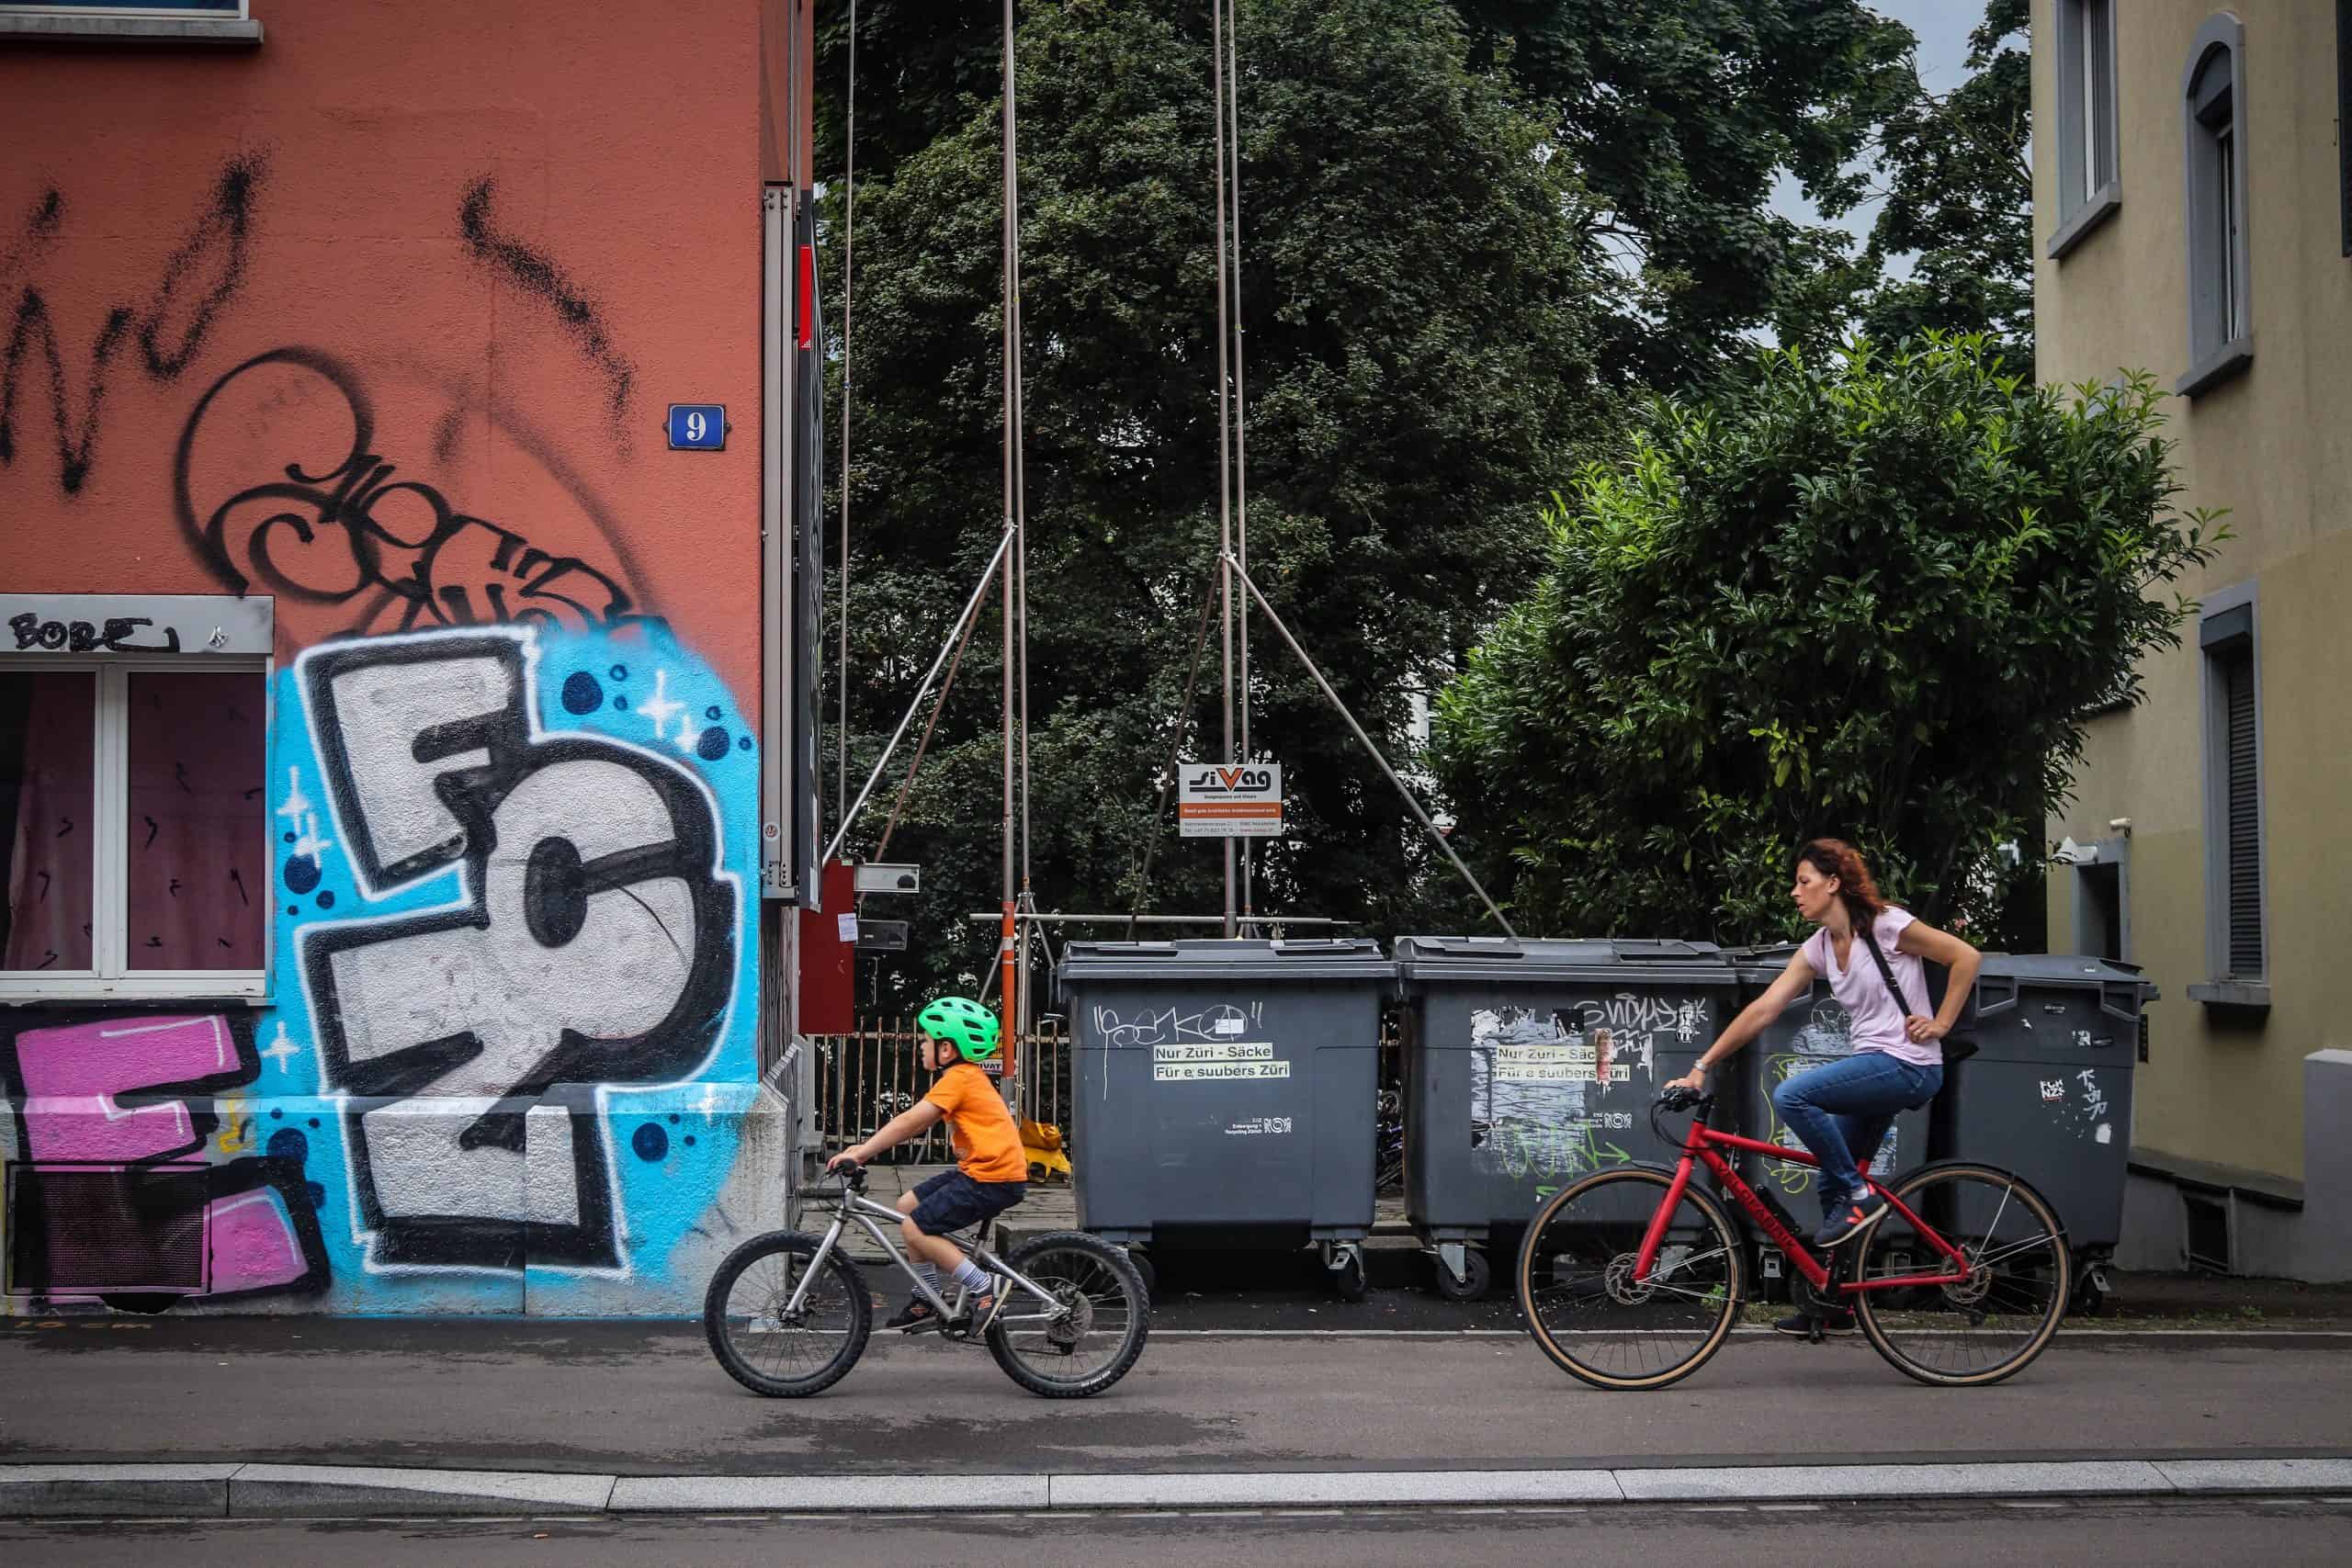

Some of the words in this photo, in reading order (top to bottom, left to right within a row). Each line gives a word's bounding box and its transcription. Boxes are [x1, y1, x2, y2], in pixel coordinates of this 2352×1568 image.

[686, 412, 707, 441] 9
[1156, 1048, 1182, 1059] Nur
[1185, 1047, 1214, 1058] Züri
[1227, 1046, 1272, 1057] Säcke
[1498, 1049, 1522, 1059] Nur
[1569, 1048, 1596, 1060] Säc
[1156, 1066, 1181, 1077] Für
[1184, 1069, 1193, 1077] e
[1197, 1066, 1256, 1077] suubers
[1260, 1065, 1289, 1076] Züri
[1538, 1066, 1596, 1078] suubers
[1608, 1066, 1628, 1078] üri
